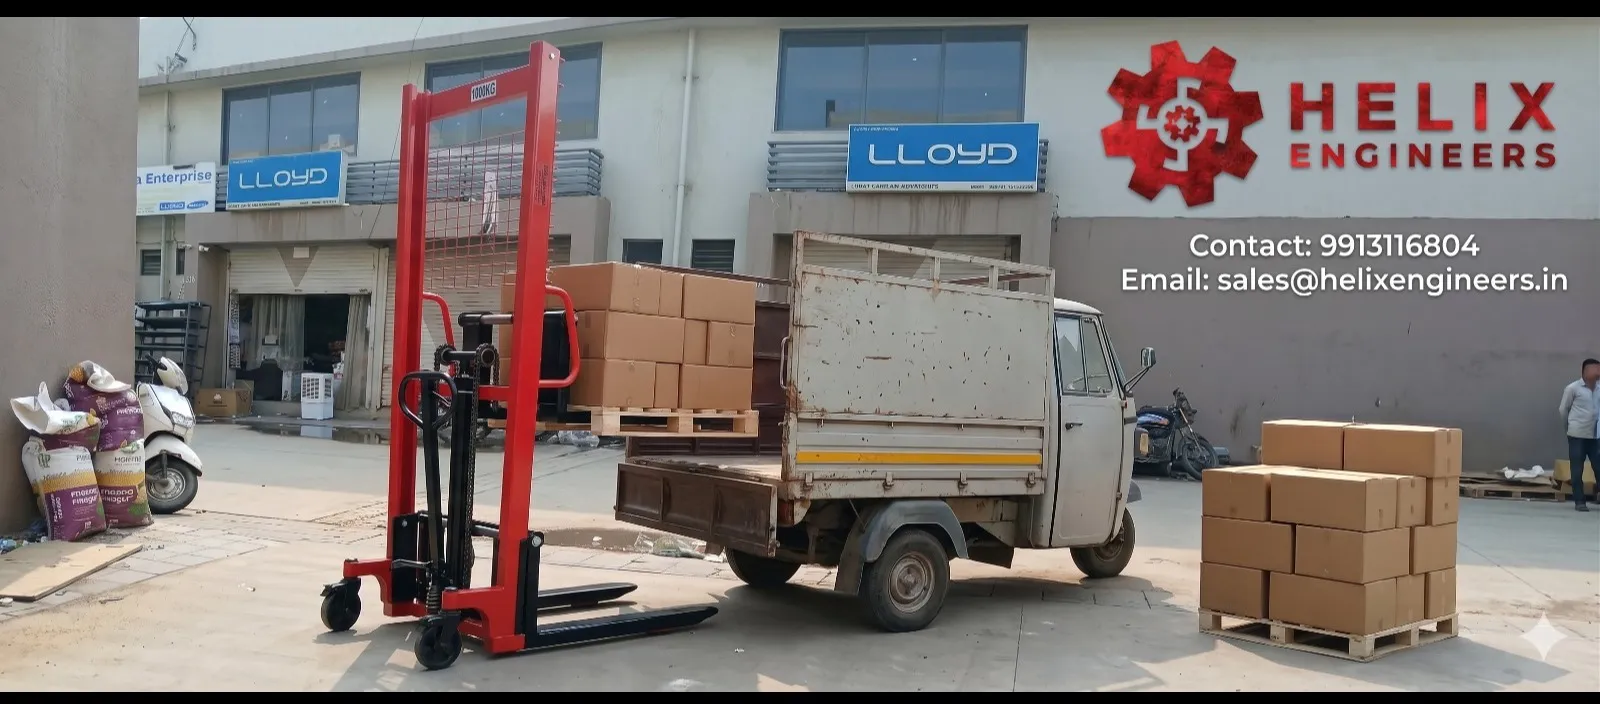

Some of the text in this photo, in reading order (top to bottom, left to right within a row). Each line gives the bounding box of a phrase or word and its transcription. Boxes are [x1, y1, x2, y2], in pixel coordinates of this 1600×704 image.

[472, 82, 496, 100] 1000KG
[868, 143, 1018, 165] LLOYD
[145, 169, 212, 185] Enterprise
[239, 167, 327, 189] LLOYD
